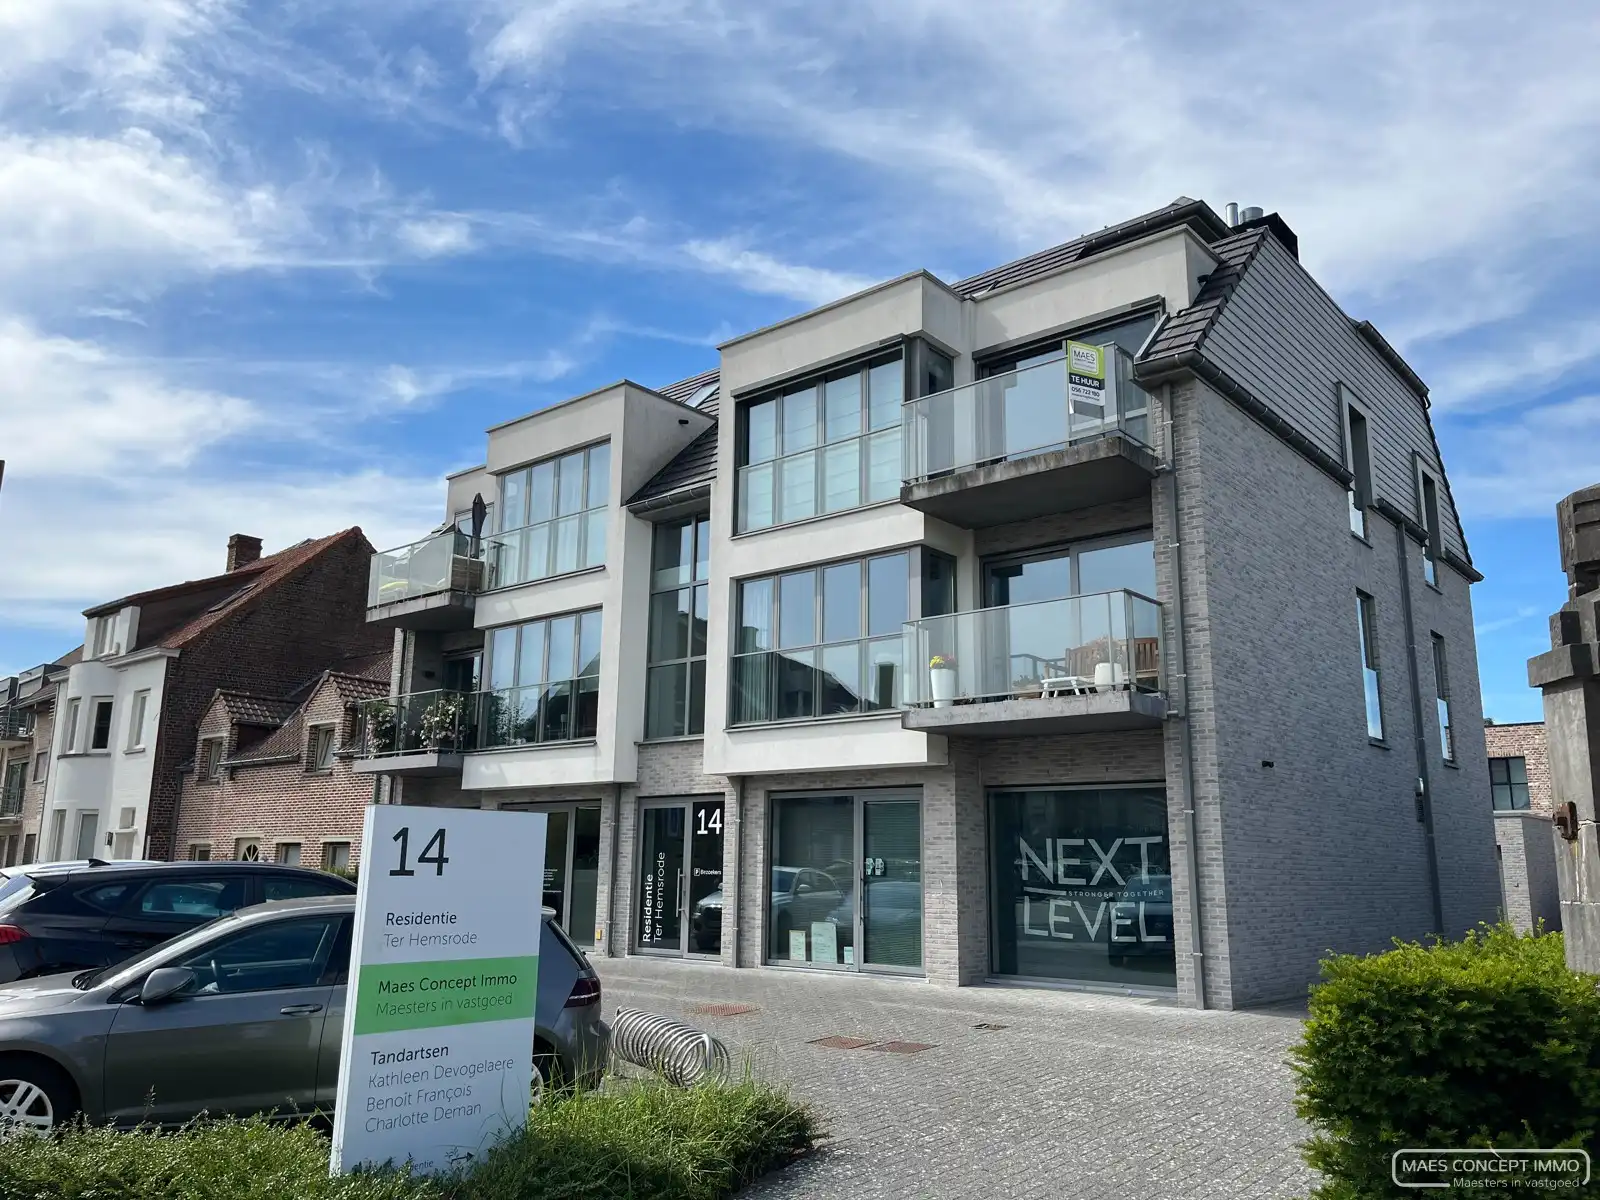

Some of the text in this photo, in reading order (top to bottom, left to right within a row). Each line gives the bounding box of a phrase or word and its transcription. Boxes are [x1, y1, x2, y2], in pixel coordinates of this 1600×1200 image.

[1074, 350, 1095, 362] MAES
[1071, 375, 1100, 387] TE HUUR
[697, 808, 722, 835] 14
[389, 826, 449, 877] 14
[1019, 835, 1163, 886] NEXT
[654, 852, 666, 943] Ter Hemsrode
[1068, 889, 1165, 898] STRONGER TOGETHER
[386, 911, 457, 927] Residentie
[642, 874, 653, 943] Residentie
[1024, 895, 1167, 943] LEVEL
[384, 932, 478, 948] Ter Hemsrode
[378, 973, 518, 995] Maes Concept Immo
[376, 993, 514, 1017] Maesters in vastgoed
[371, 1044, 449, 1066] Tandartsen
[369, 1056, 515, 1089] Kathleen Devogelaere
[366, 1084, 472, 1112] Benoît François
[365, 1102, 482, 1133] Charlotte Deman
